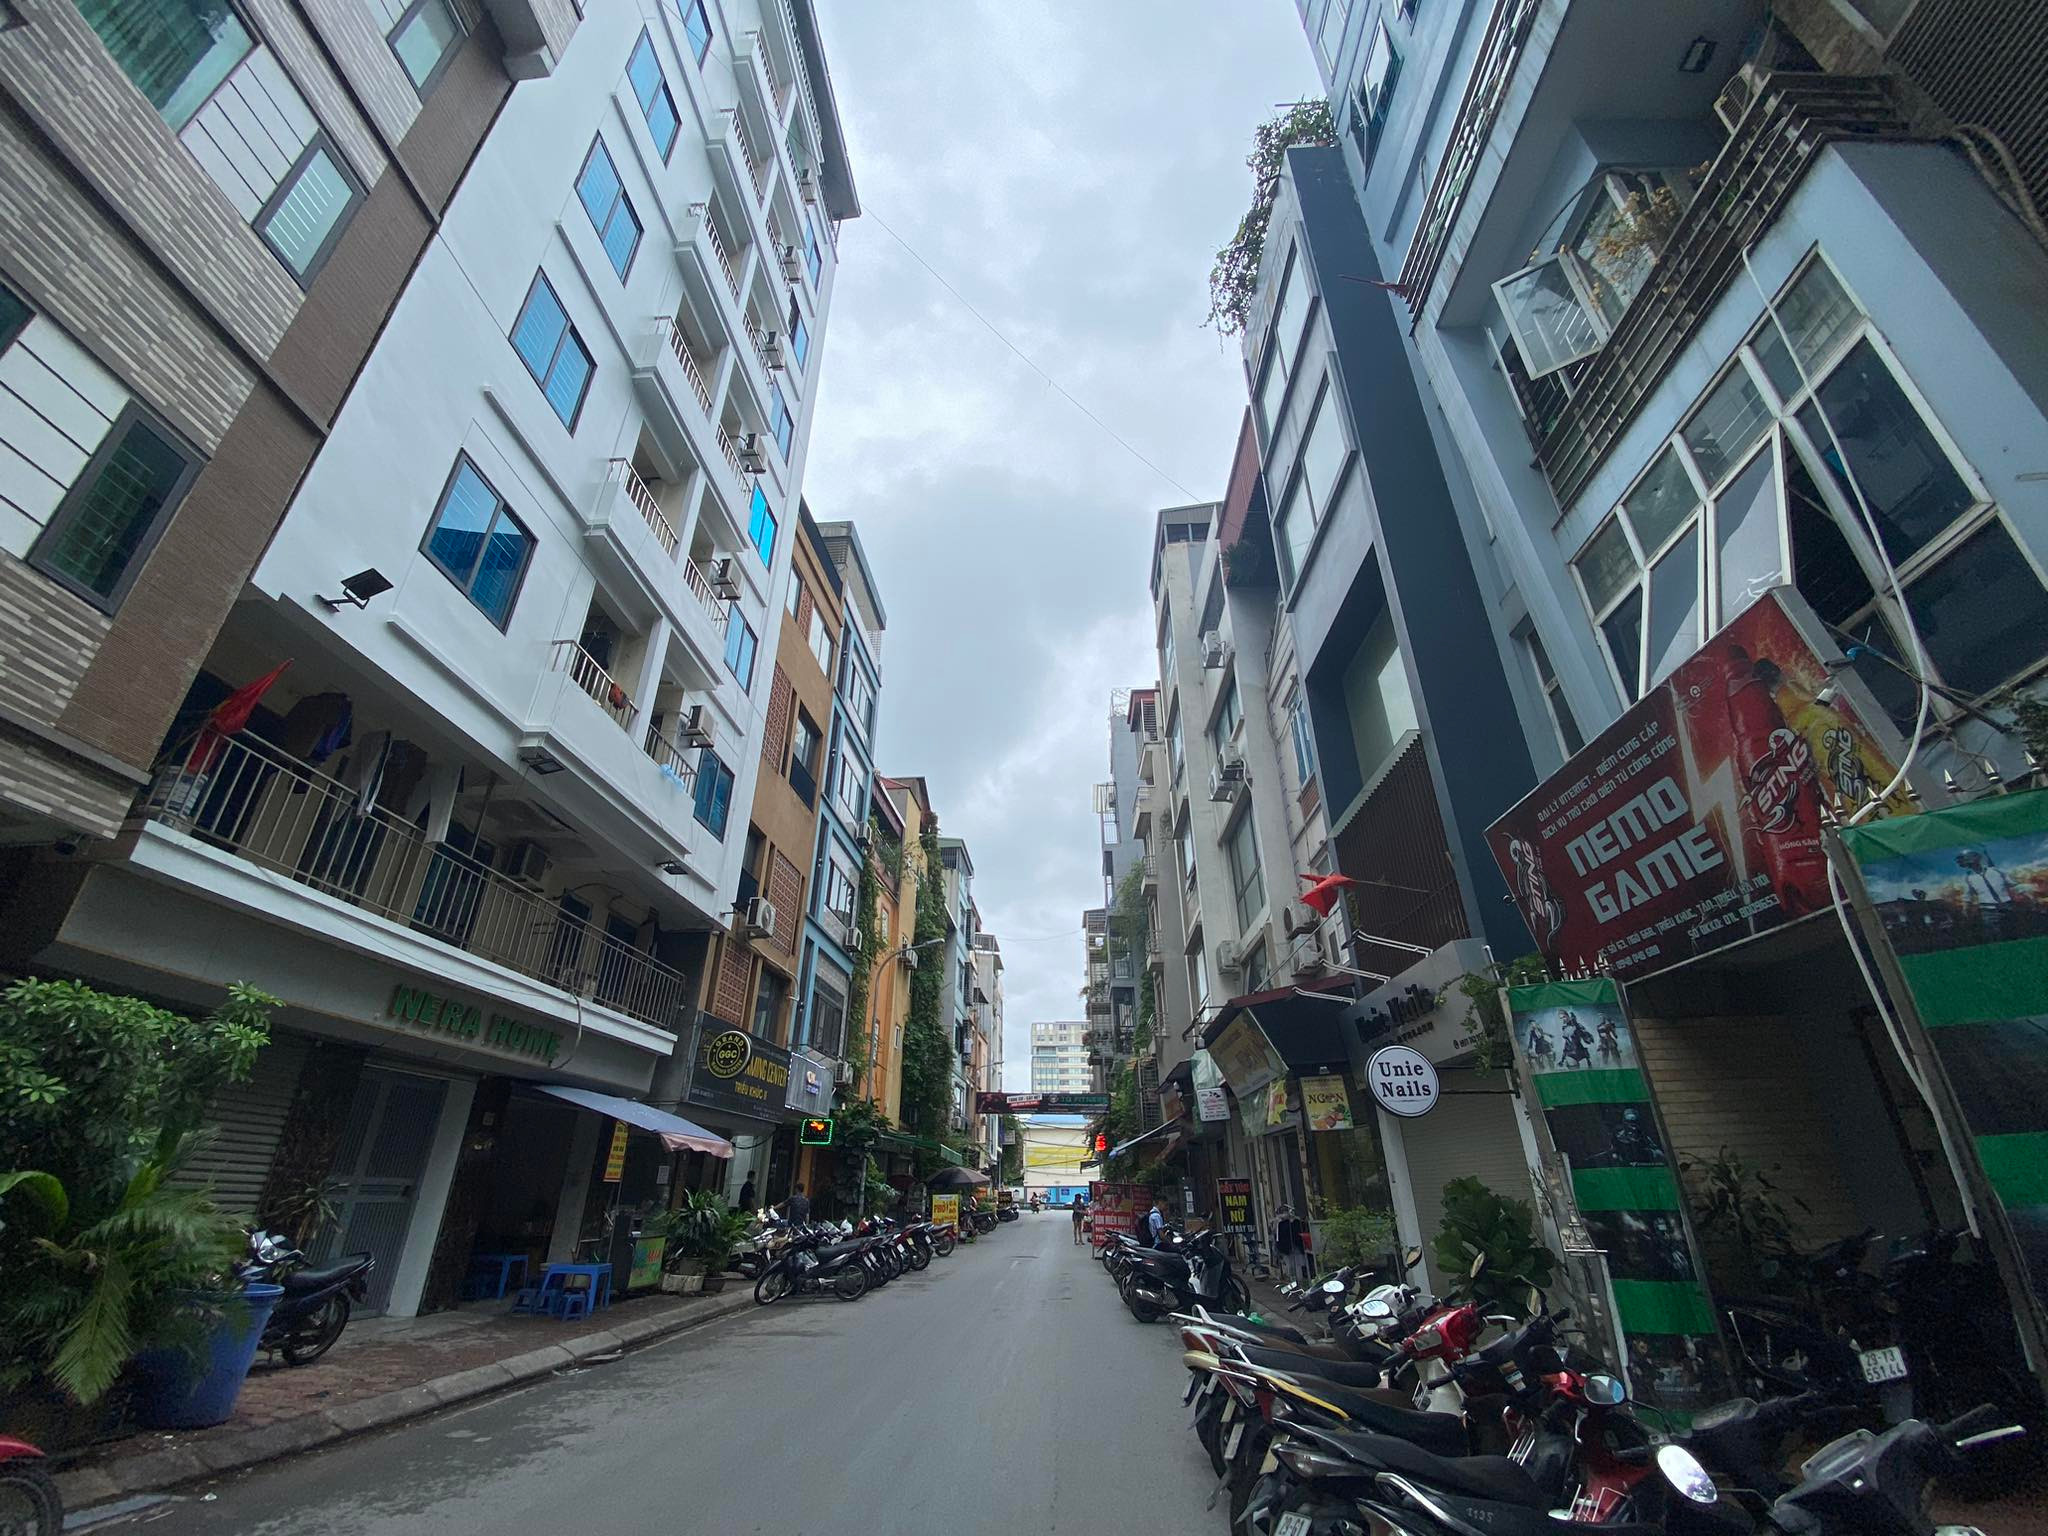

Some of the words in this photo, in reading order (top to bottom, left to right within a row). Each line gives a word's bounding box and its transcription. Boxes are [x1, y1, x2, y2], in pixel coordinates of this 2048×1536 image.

[1560, 775, 1593, 806] INTERNET
[1617, 736, 1641, 760] CUNG
[1628, 754, 1652, 775] CÔNG
[1838, 728, 1854, 797] STING
[1757, 740, 1808, 814] STING
[1564, 775, 1689, 878] NEMO
[1584, 822, 1724, 925] GAME
[393, 984, 482, 1036] NERA
[491, 1014, 563, 1062] HOME
[718, 1048, 738, 1060] GGC
[766, 1061, 788, 1088] CENTER
[1378, 1060, 1424, 1077] Unie
[1380, 1080, 1432, 1098] Nails
[1225, 1195, 1248, 1207] NAM
[1230, 1207, 1246, 1223] NỮ
